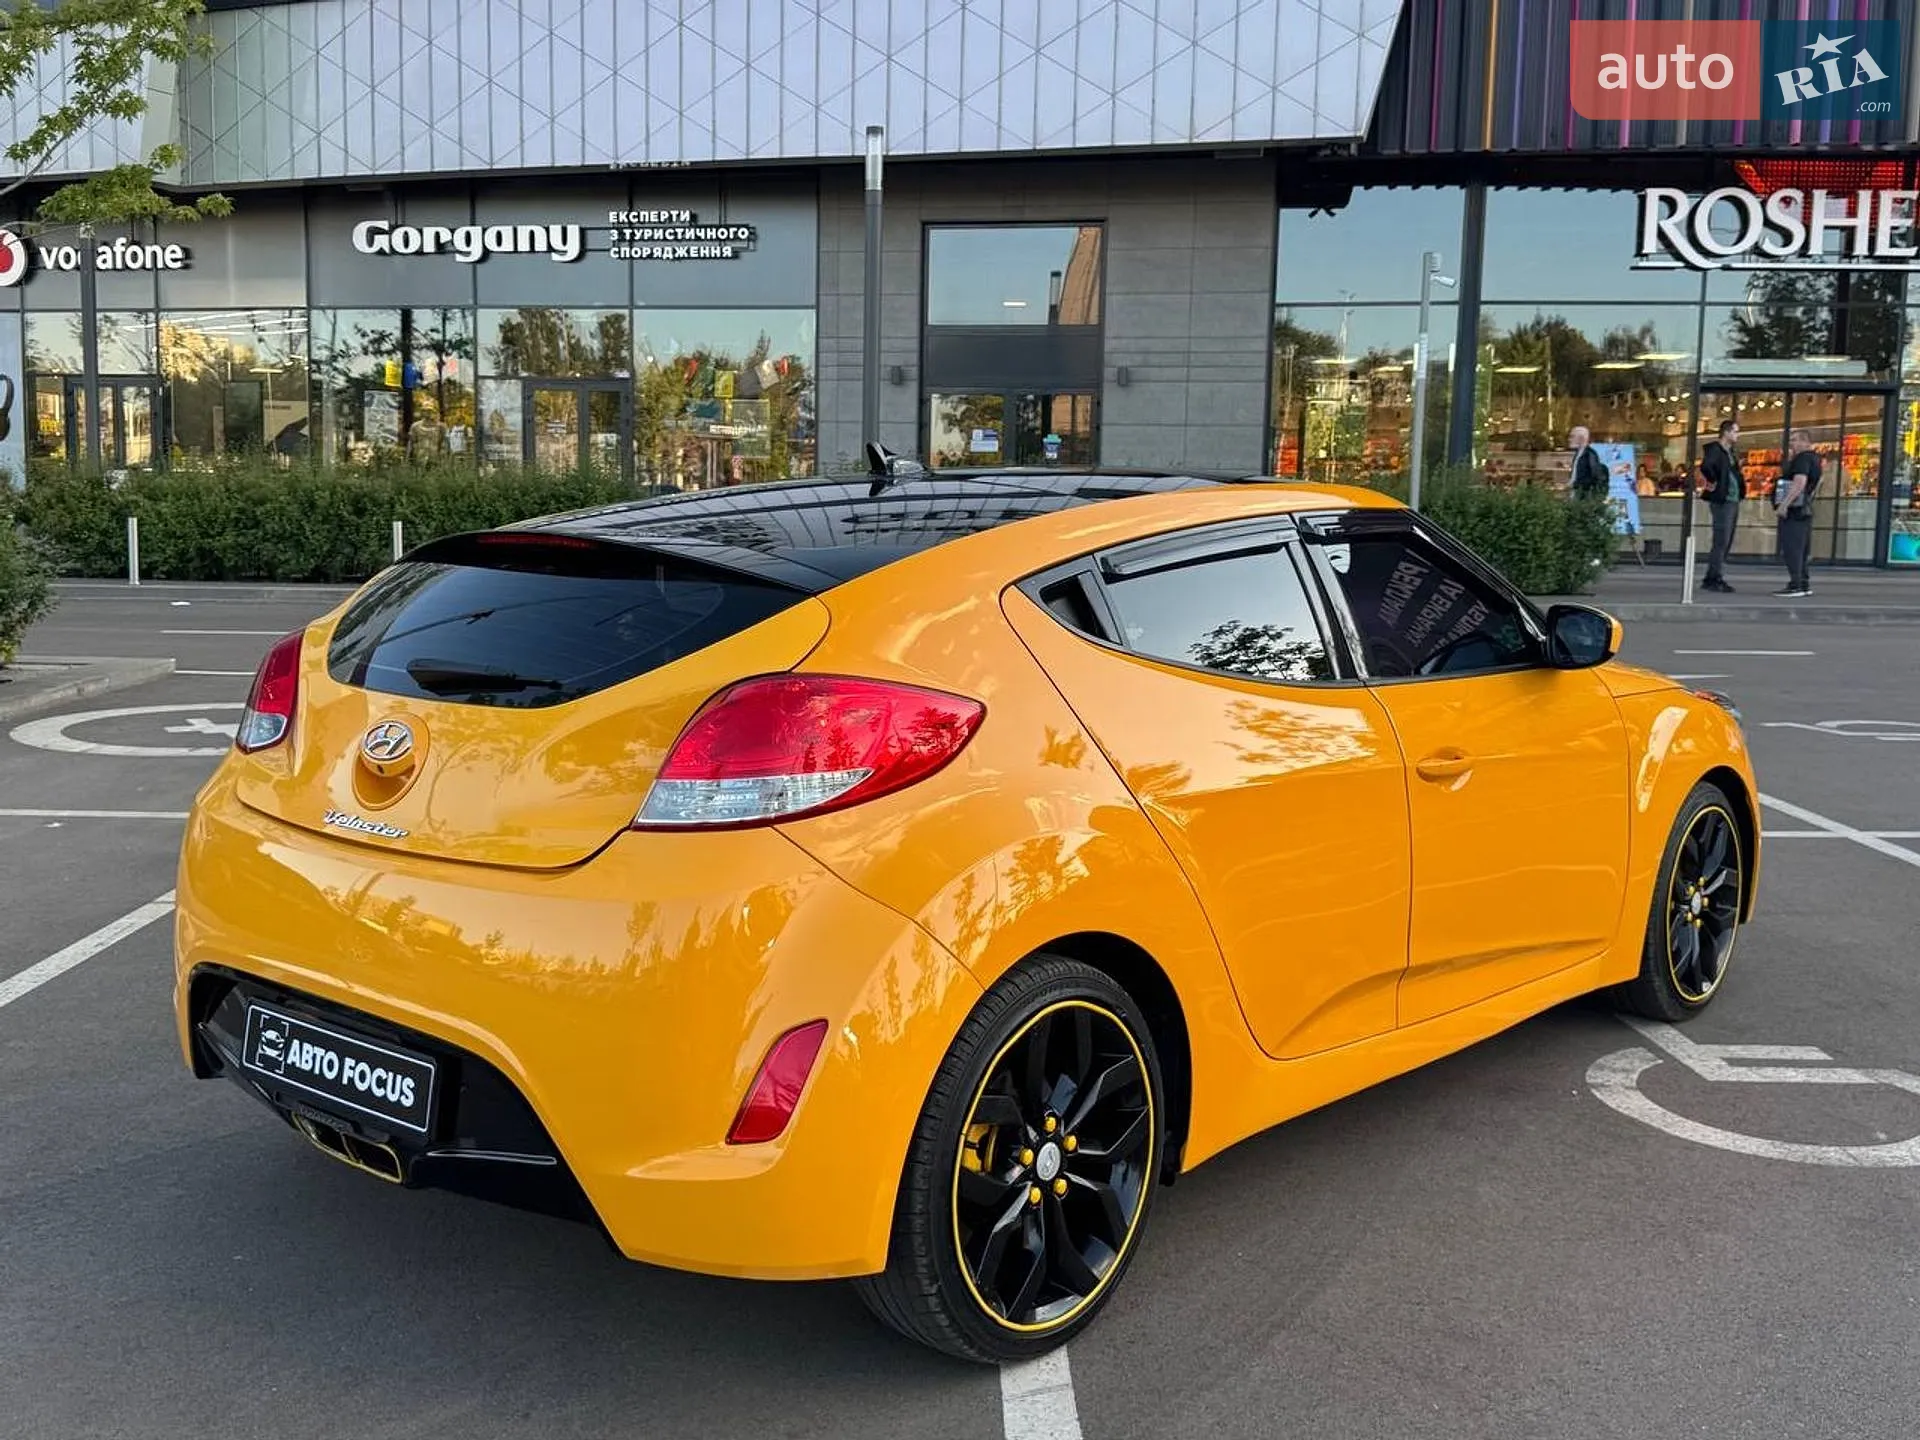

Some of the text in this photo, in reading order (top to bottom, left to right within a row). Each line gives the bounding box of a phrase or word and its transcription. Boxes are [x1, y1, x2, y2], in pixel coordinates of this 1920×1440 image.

[609, 210, 691, 223] ЕКСПЕРТИ
[610, 226, 749, 241] З ТУРИСТИЧНОГО
[1641, 187, 1919, 268] ROSHE
[39, 236, 183, 270] voafone
[352, 219, 580, 263] Gorgany
[609, 245, 732, 260] СПОРЯДЖЕННЯ
[286, 1038, 415, 1108] АВТО FOCUS
